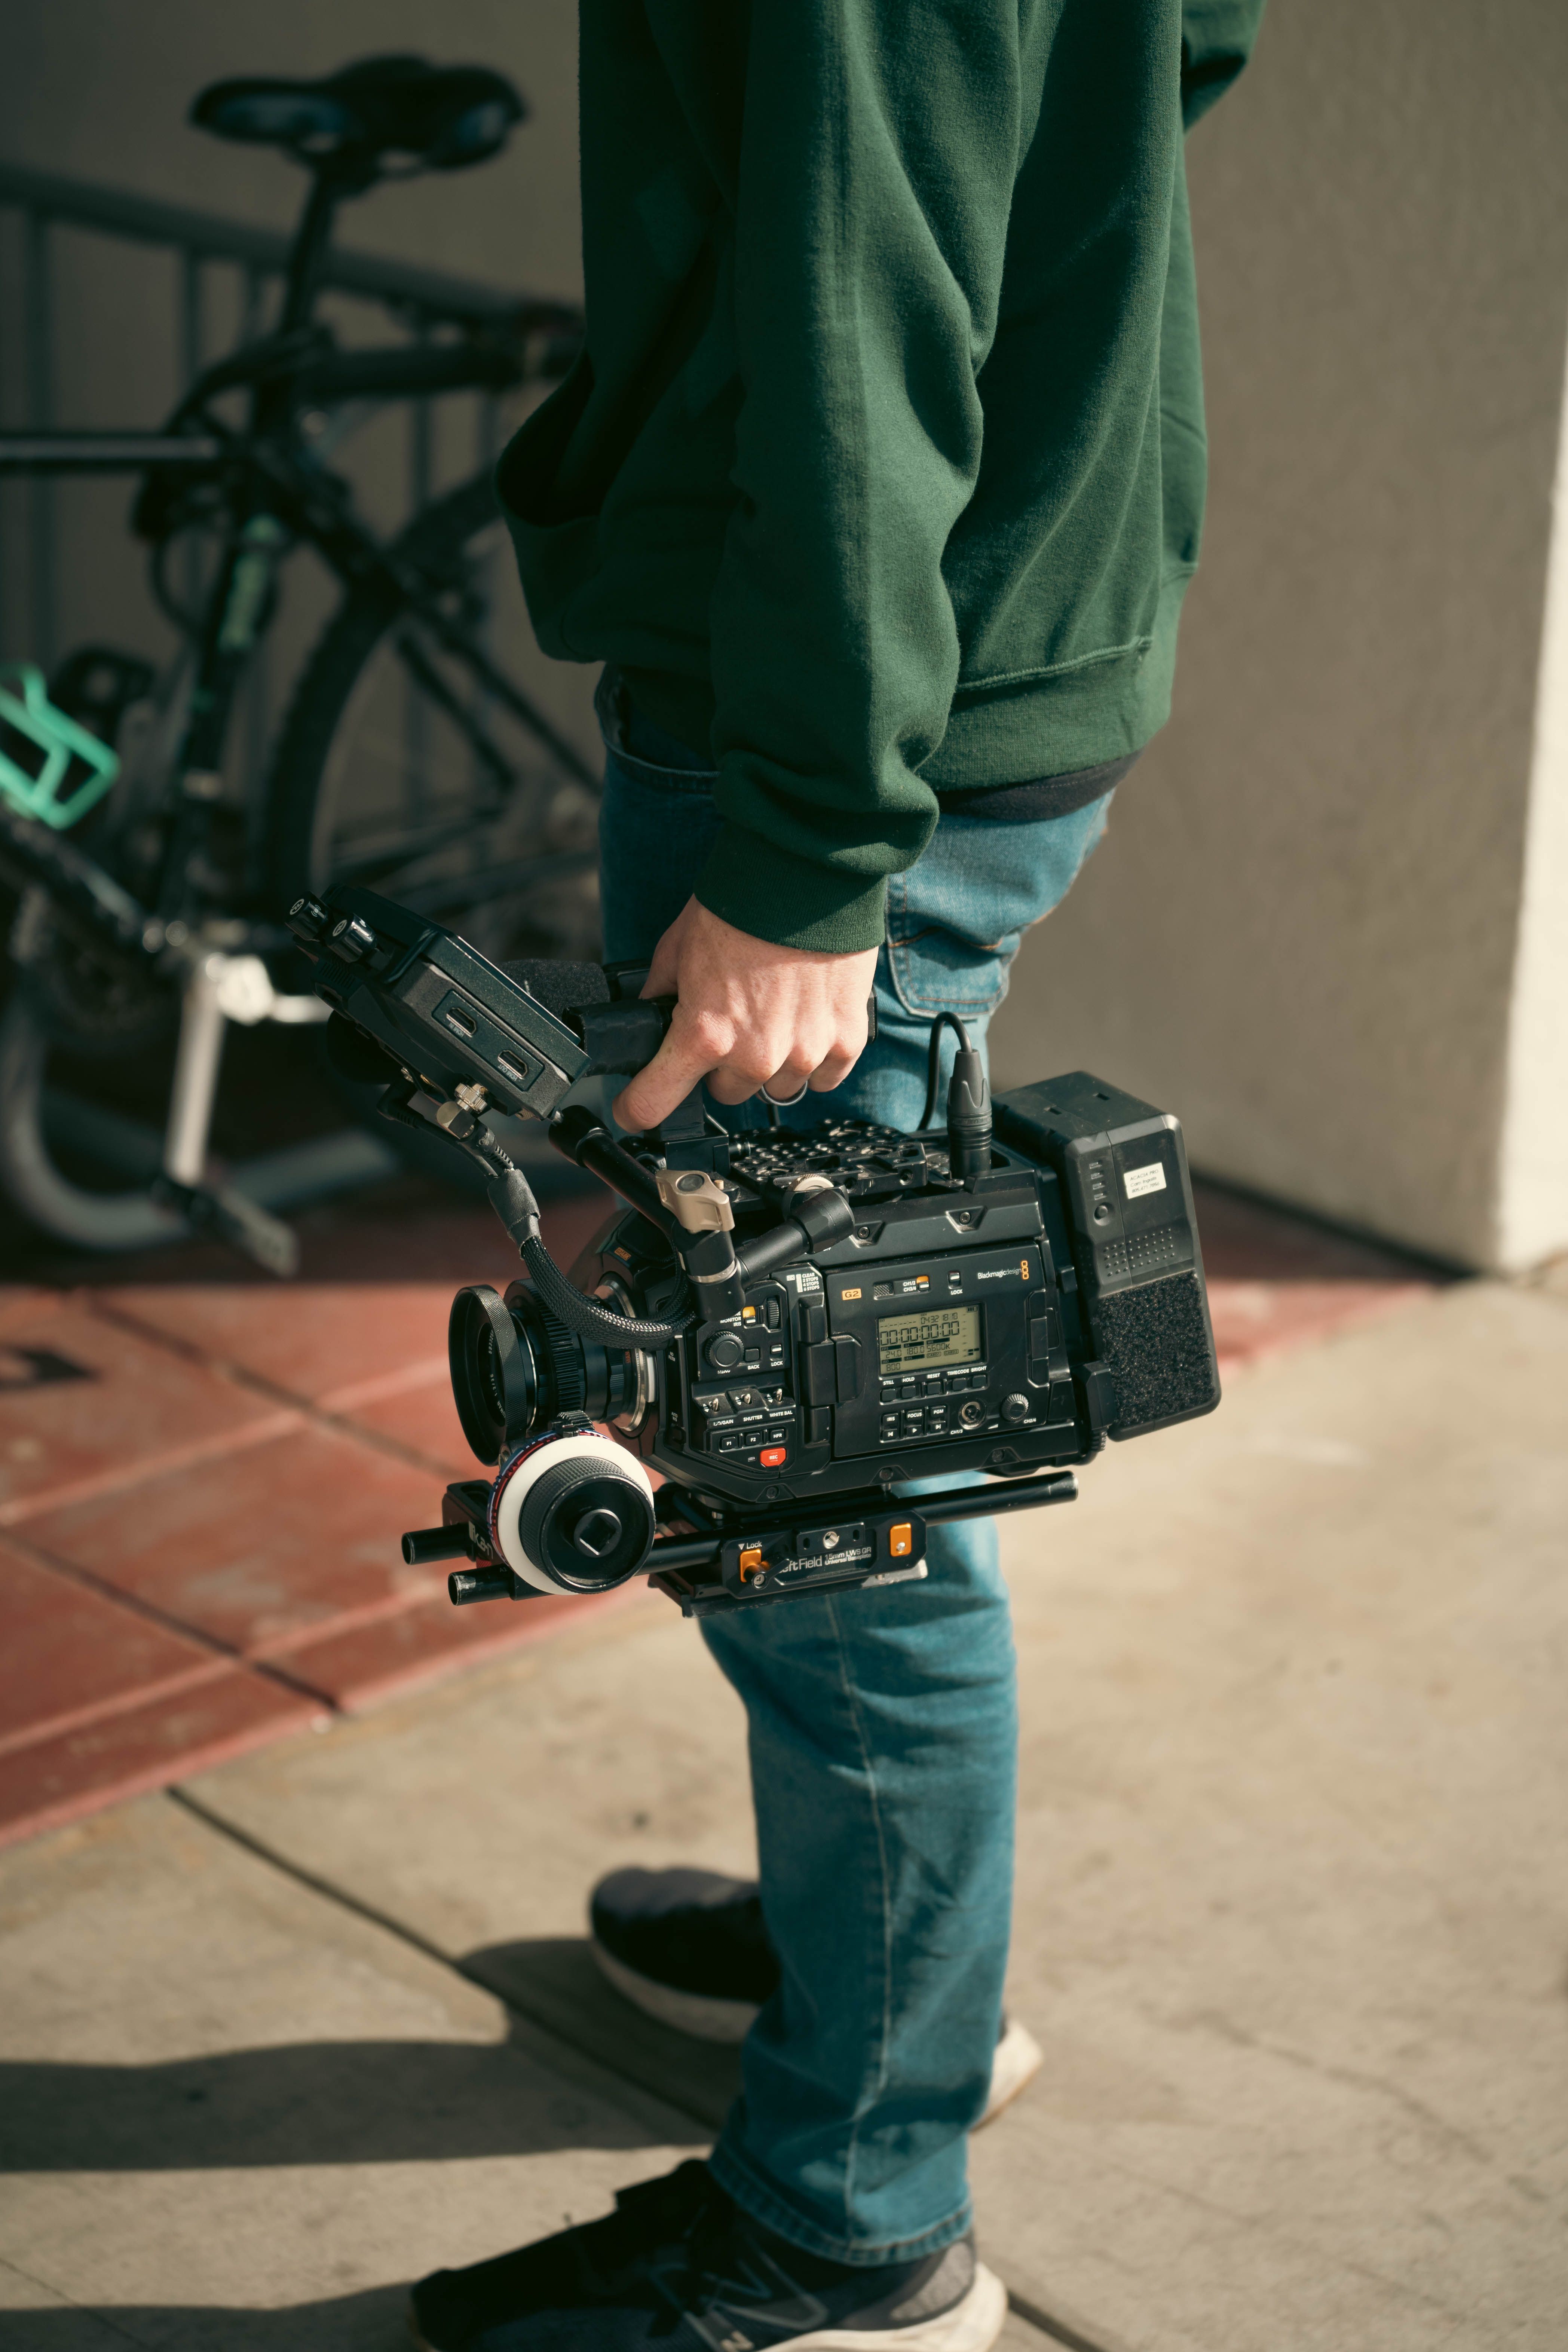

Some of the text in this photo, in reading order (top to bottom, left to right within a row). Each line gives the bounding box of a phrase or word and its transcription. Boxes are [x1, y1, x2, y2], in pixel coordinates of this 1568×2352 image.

[453, 1026, 465, 1038] HDMI
[498, 1064, 518, 1081] HDMI OUT
[1130, 1173, 1148, 1181] ACACIA
[880, 1321, 960, 1345] 00:00:00:00
[907, 1346, 924, 1355] 180.0
[927, 1343, 950, 1352] 5600K
[886, 1350, 901, 1359] 24.0
[886, 1363, 900, 1371] 800
[747, 1541, 762, 1549] Lock
[825, 1553, 871, 1565] Universal Baseplate
